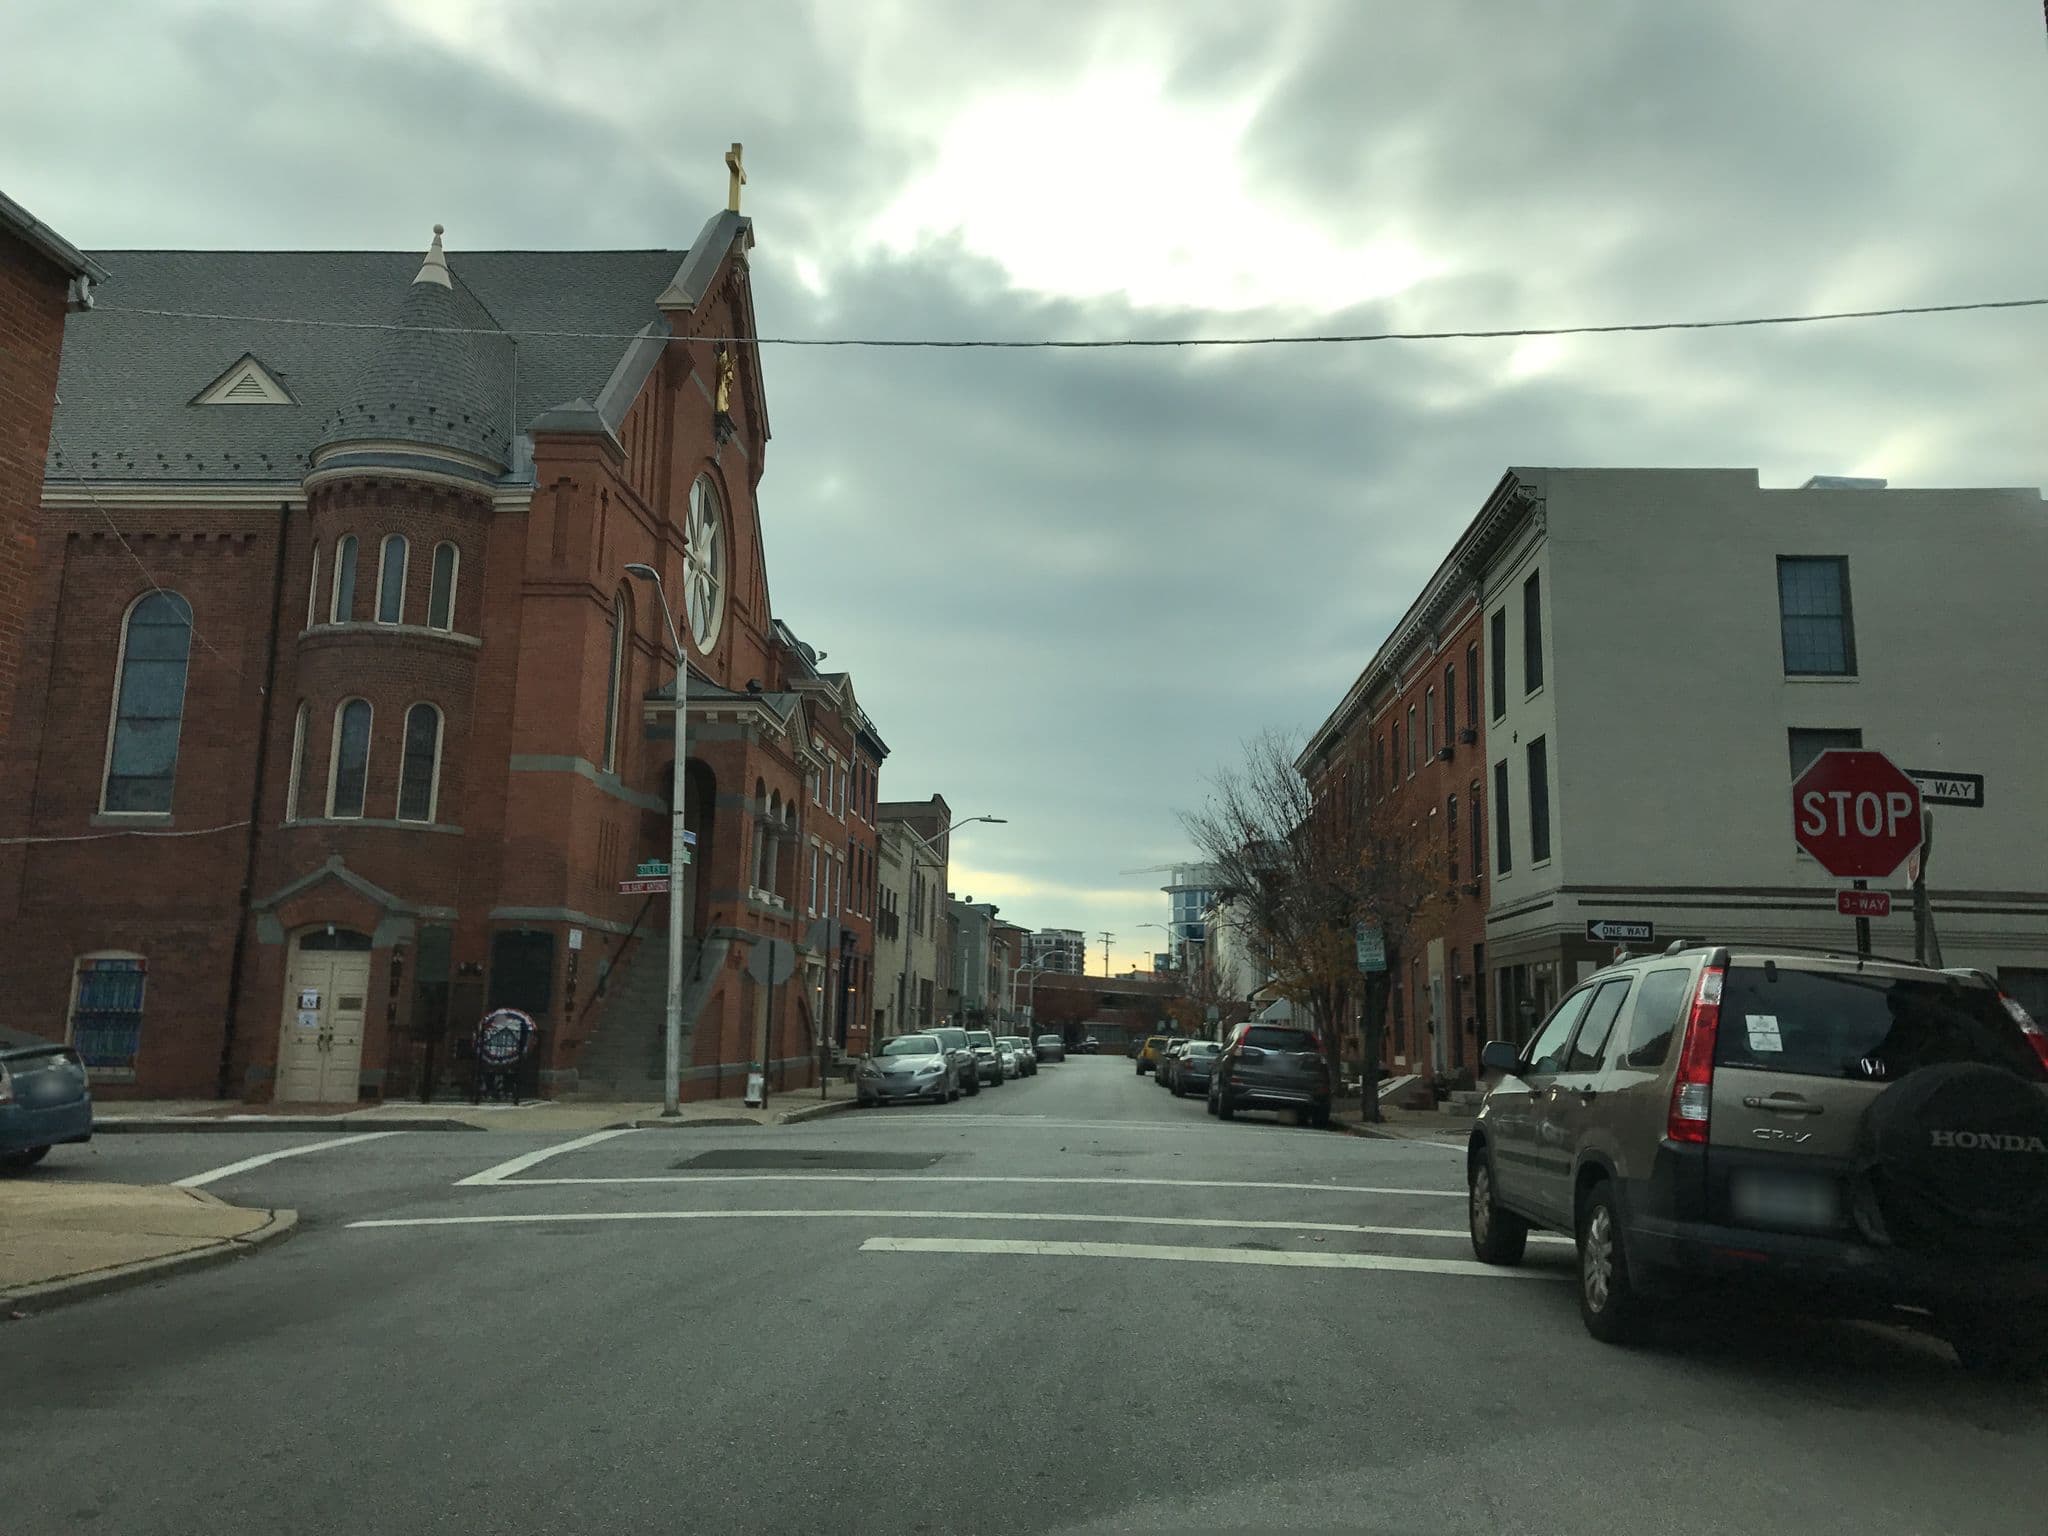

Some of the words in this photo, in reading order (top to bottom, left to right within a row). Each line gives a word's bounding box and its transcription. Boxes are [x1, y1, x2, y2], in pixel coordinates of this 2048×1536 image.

[1935, 781, 1971, 797] WAY
[1802, 791, 1912, 837] STOP
[1843, 897, 1886, 910] 3-WAY
[1602, 926, 1622, 935] ONE
[1626, 927, 1647, 936] WAY
[1929, 1130, 2048, 1153] HONDA
